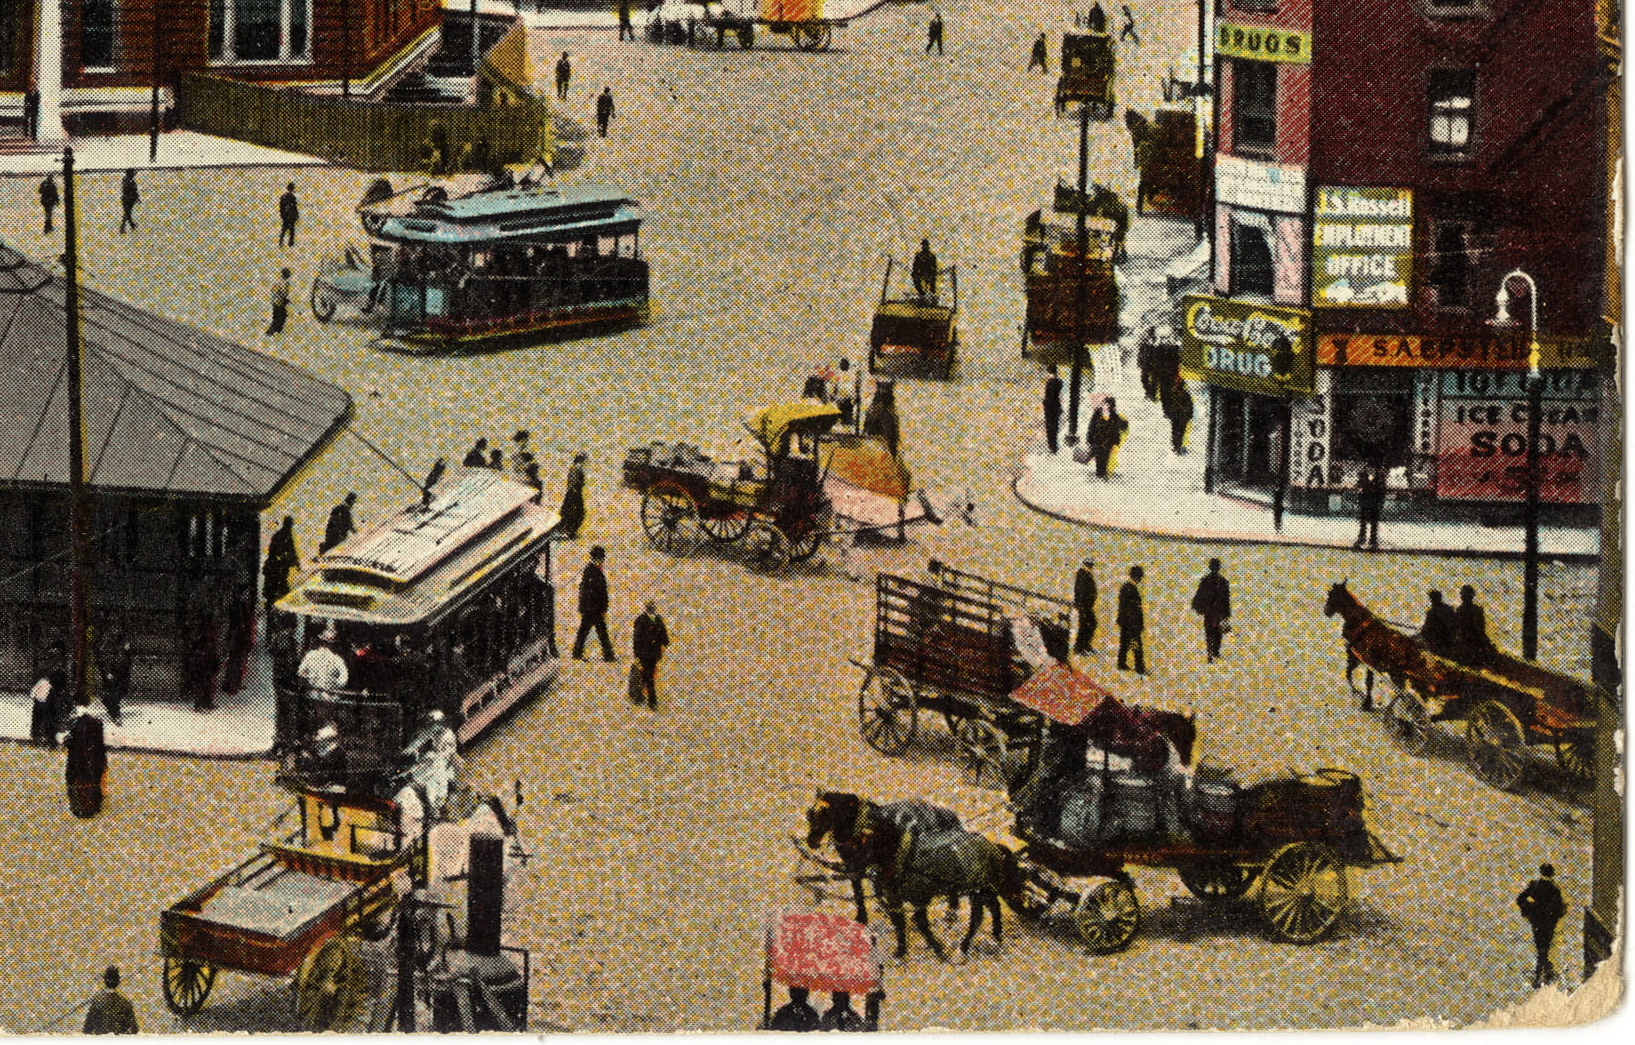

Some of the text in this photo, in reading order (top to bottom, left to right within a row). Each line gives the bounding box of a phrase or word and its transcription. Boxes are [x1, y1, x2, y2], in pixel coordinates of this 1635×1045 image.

[1314, 222, 1412, 247] EMPLOYMENT
[1325, 254, 1397, 277] OFFICE
[1202, 344, 1273, 378] DRUG
[1456, 405, 1502, 425] ICE
[1470, 431, 1590, 459] SODA
